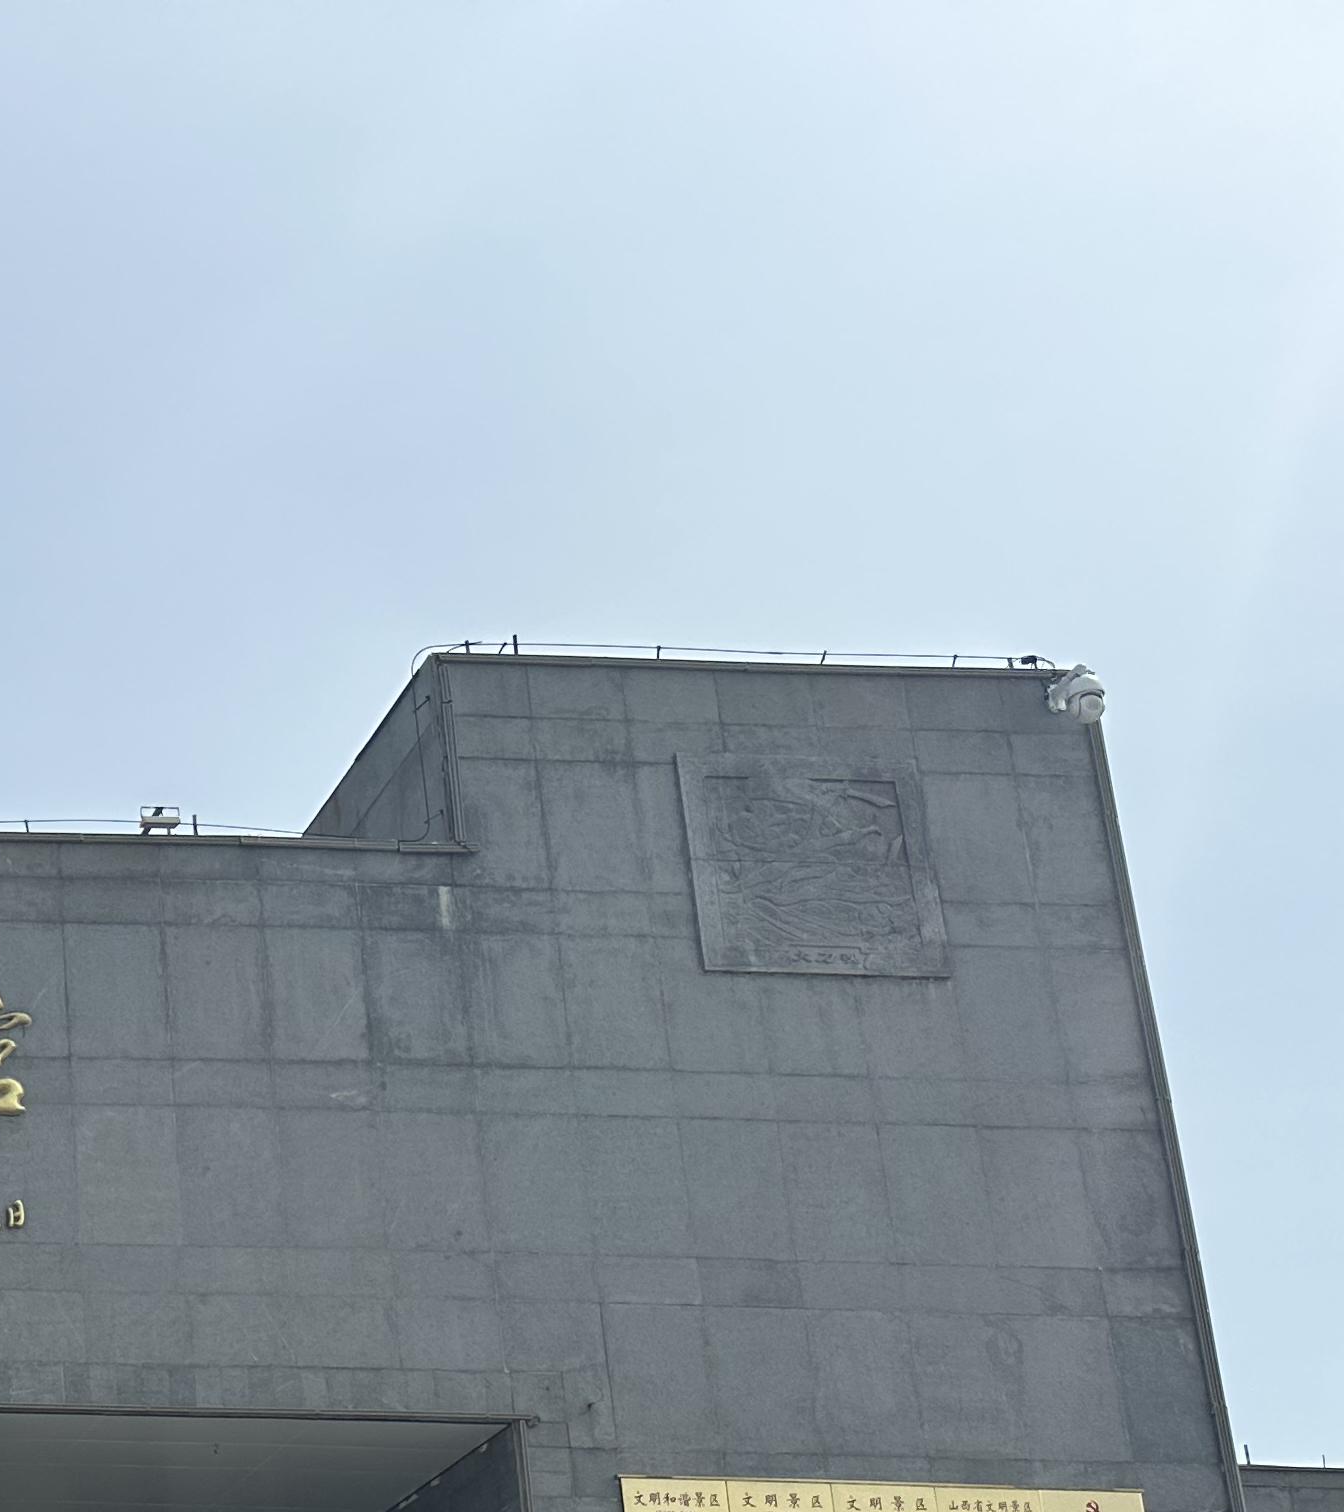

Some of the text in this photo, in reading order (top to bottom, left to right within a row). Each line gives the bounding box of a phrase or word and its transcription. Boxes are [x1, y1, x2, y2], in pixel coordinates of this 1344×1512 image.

[633, 1491, 721, 1508] 文明和谐景区
[741, 1492, 824, 1509] 文明景区
[846, 1494, 928, 1512] 文明景区
[948, 1499, 1032, 1512] 山西省文明景区
